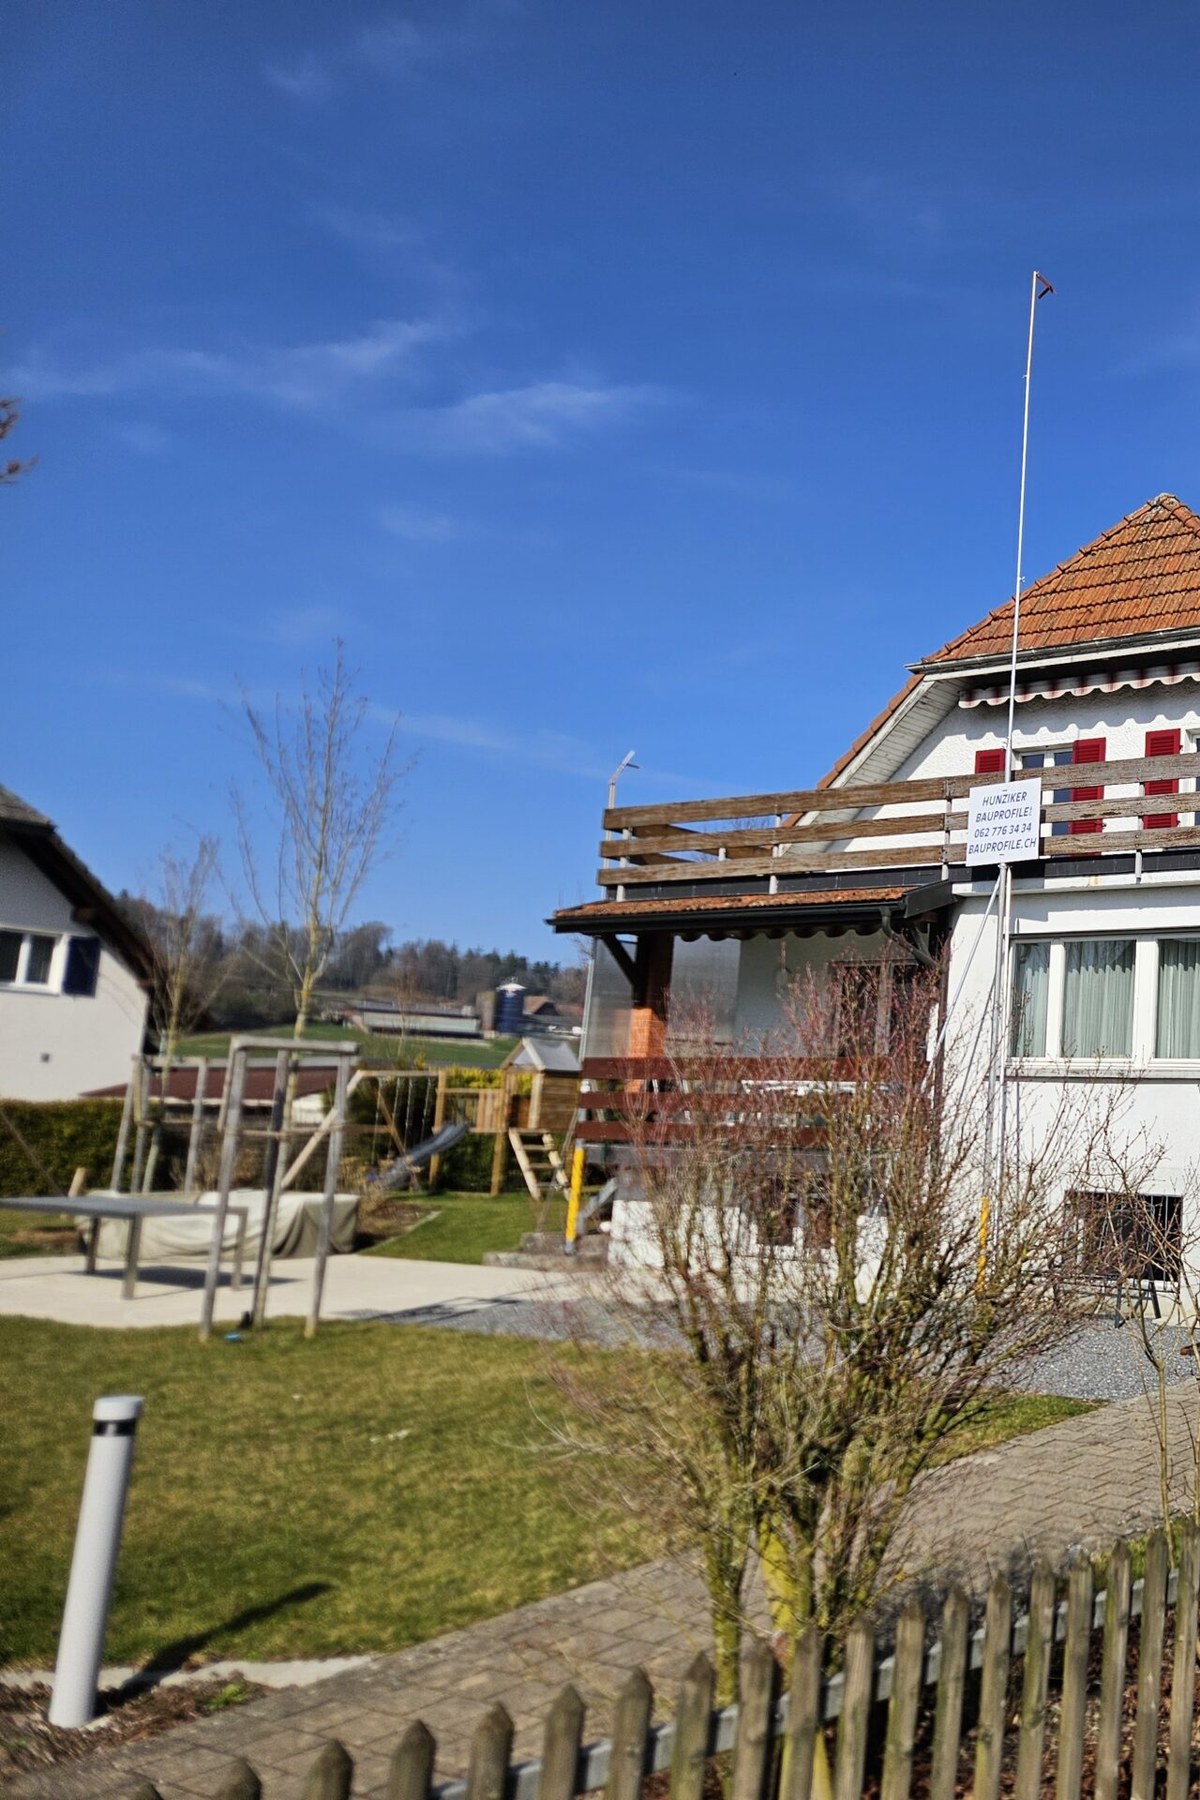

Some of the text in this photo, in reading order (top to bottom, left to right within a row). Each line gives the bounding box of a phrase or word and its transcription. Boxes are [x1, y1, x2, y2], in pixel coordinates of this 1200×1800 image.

[982, 791, 1027, 806] HUNZIKER
[974, 822, 1032, 838] 062 776 34 34
[968, 837, 1037, 854] BAUPROFILE.CH
